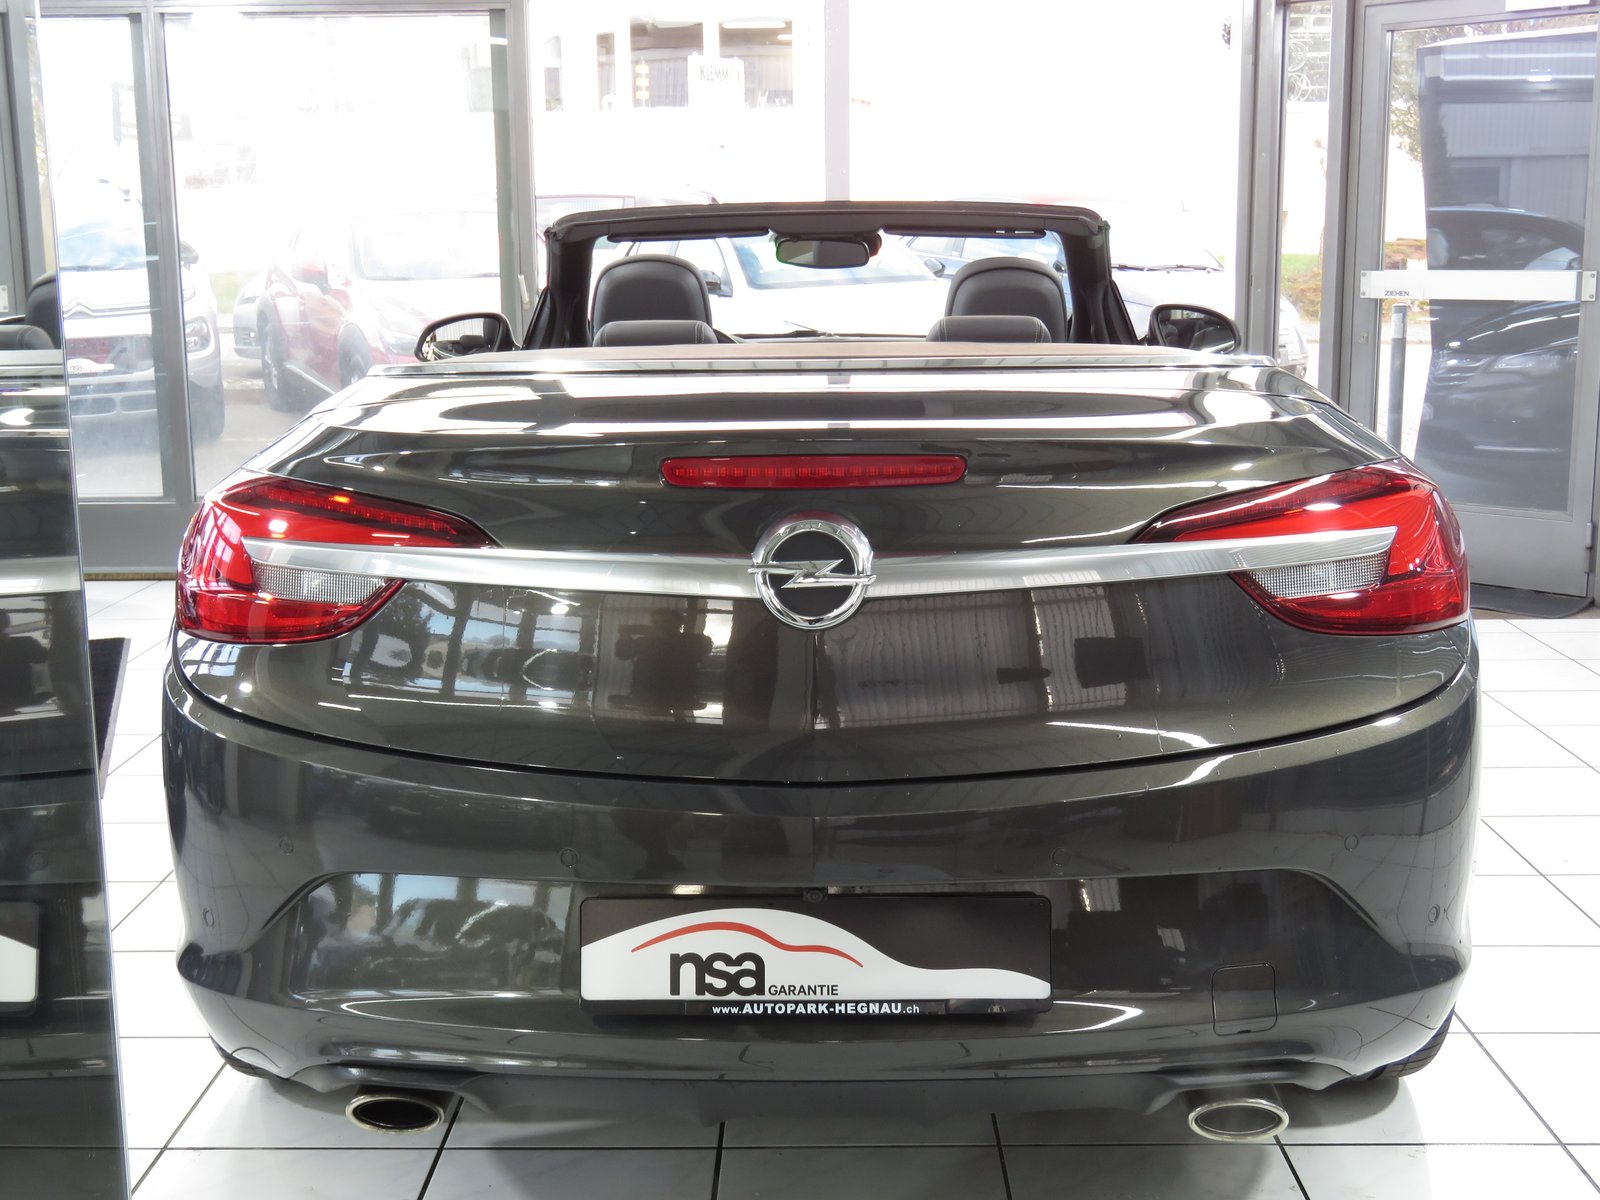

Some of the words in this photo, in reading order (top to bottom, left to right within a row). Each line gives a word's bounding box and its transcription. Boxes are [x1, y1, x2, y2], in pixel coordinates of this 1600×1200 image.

[669, 951, 766, 997] nsa
[768, 984, 839, 996] GARANTIE
[712, 1002, 920, 1015] www.AUTOPARK-HEGNAU.ch
